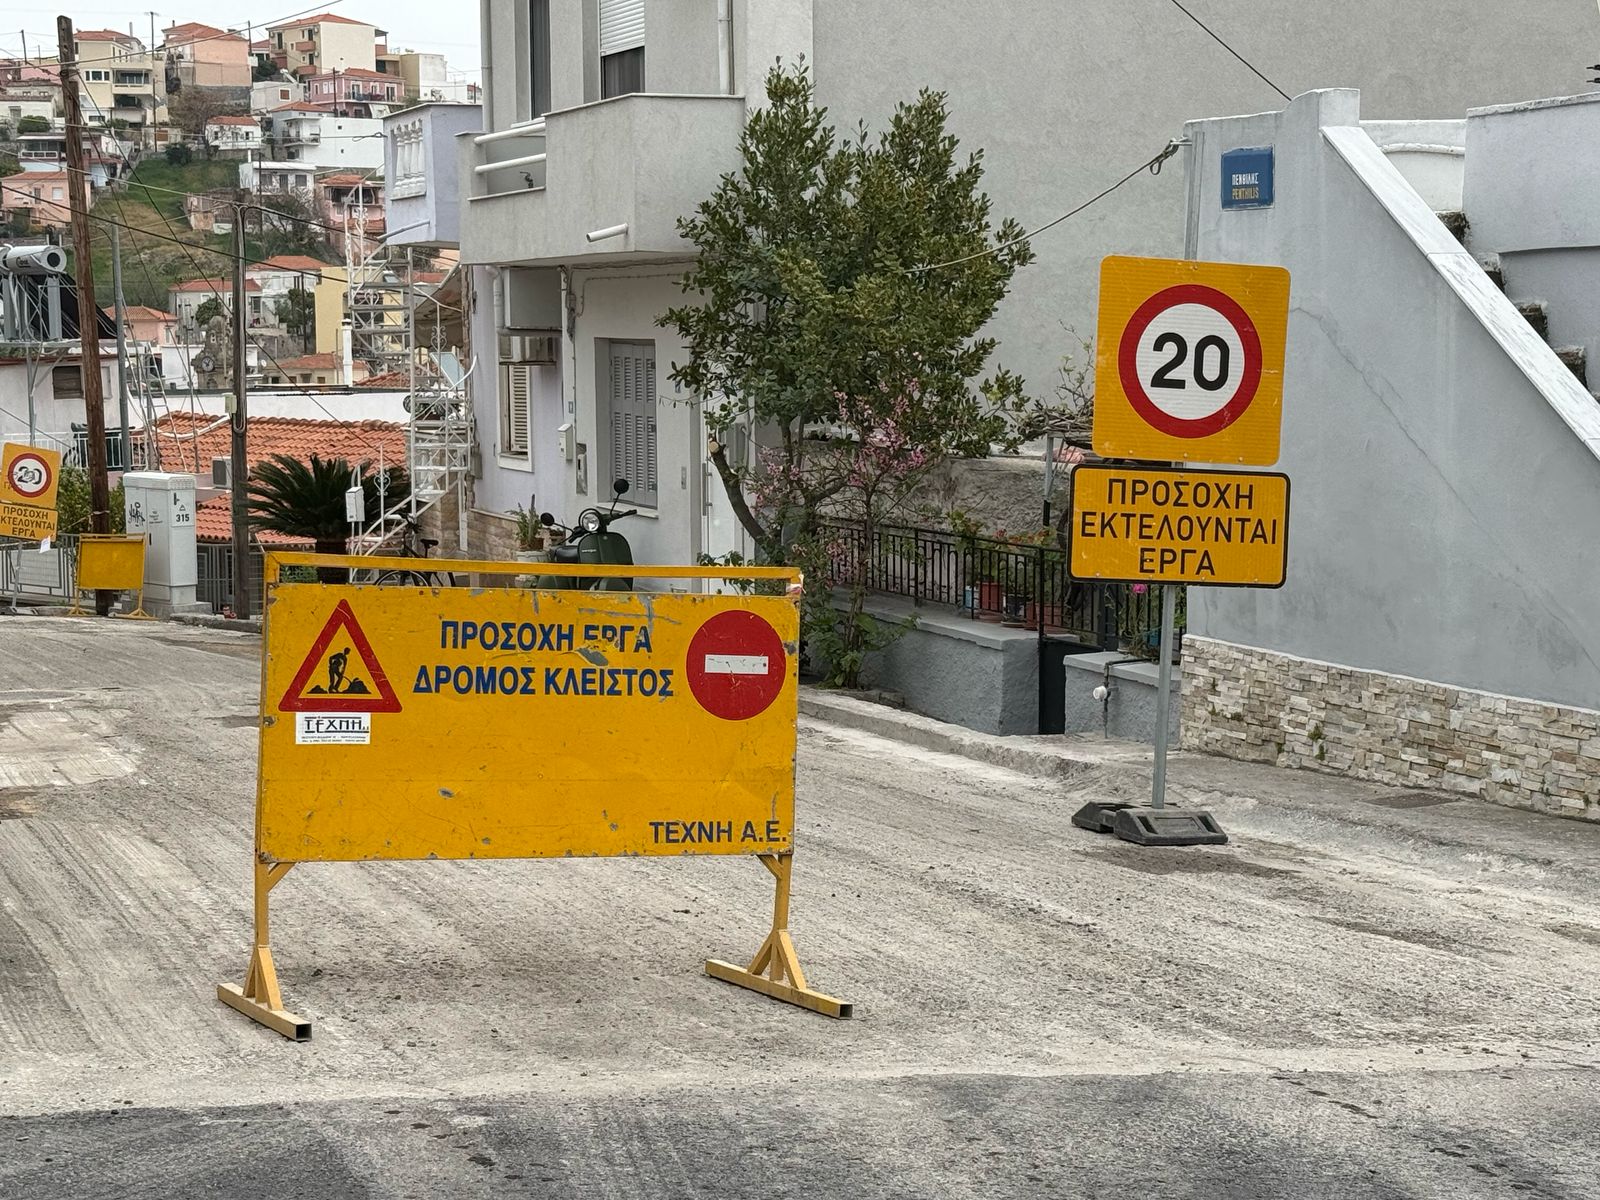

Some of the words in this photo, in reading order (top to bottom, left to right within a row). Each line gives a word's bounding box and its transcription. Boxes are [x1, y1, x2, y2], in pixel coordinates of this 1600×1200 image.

[1150, 332, 1230, 391] 20
[17, 466, 43, 485] 20
[1107, 478, 1254, 510] ΠΡΟΣΟΧΗ
[0, 515, 55, 531] ΚΤΕΛΟΥΝΤΑΙ
[3, 506, 49, 520] ΠΡΟΣΟΧΗ
[176, 514, 190, 523] 315
[12, 526, 36, 538] ΕΡΓΑ
[1081, 511, 1277, 545] ΕΚΤΕΛΟΥΝΤΑΙ
[1139, 547, 1215, 576] ΕΡΓΑ
[441, 620, 574, 652] ΠΡΟΣΟΧΗ
[584, 624, 653, 653] ΕΡΓΑ
[413, 665, 536, 695] ΔΡΟΜΟΣ
[545, 667, 674, 697] ΚΛΕΙΣΤΟΣ
[649, 820, 733, 844] ΤΕΧΝΗ
[740, 820, 787, 843] Α.Ε.
